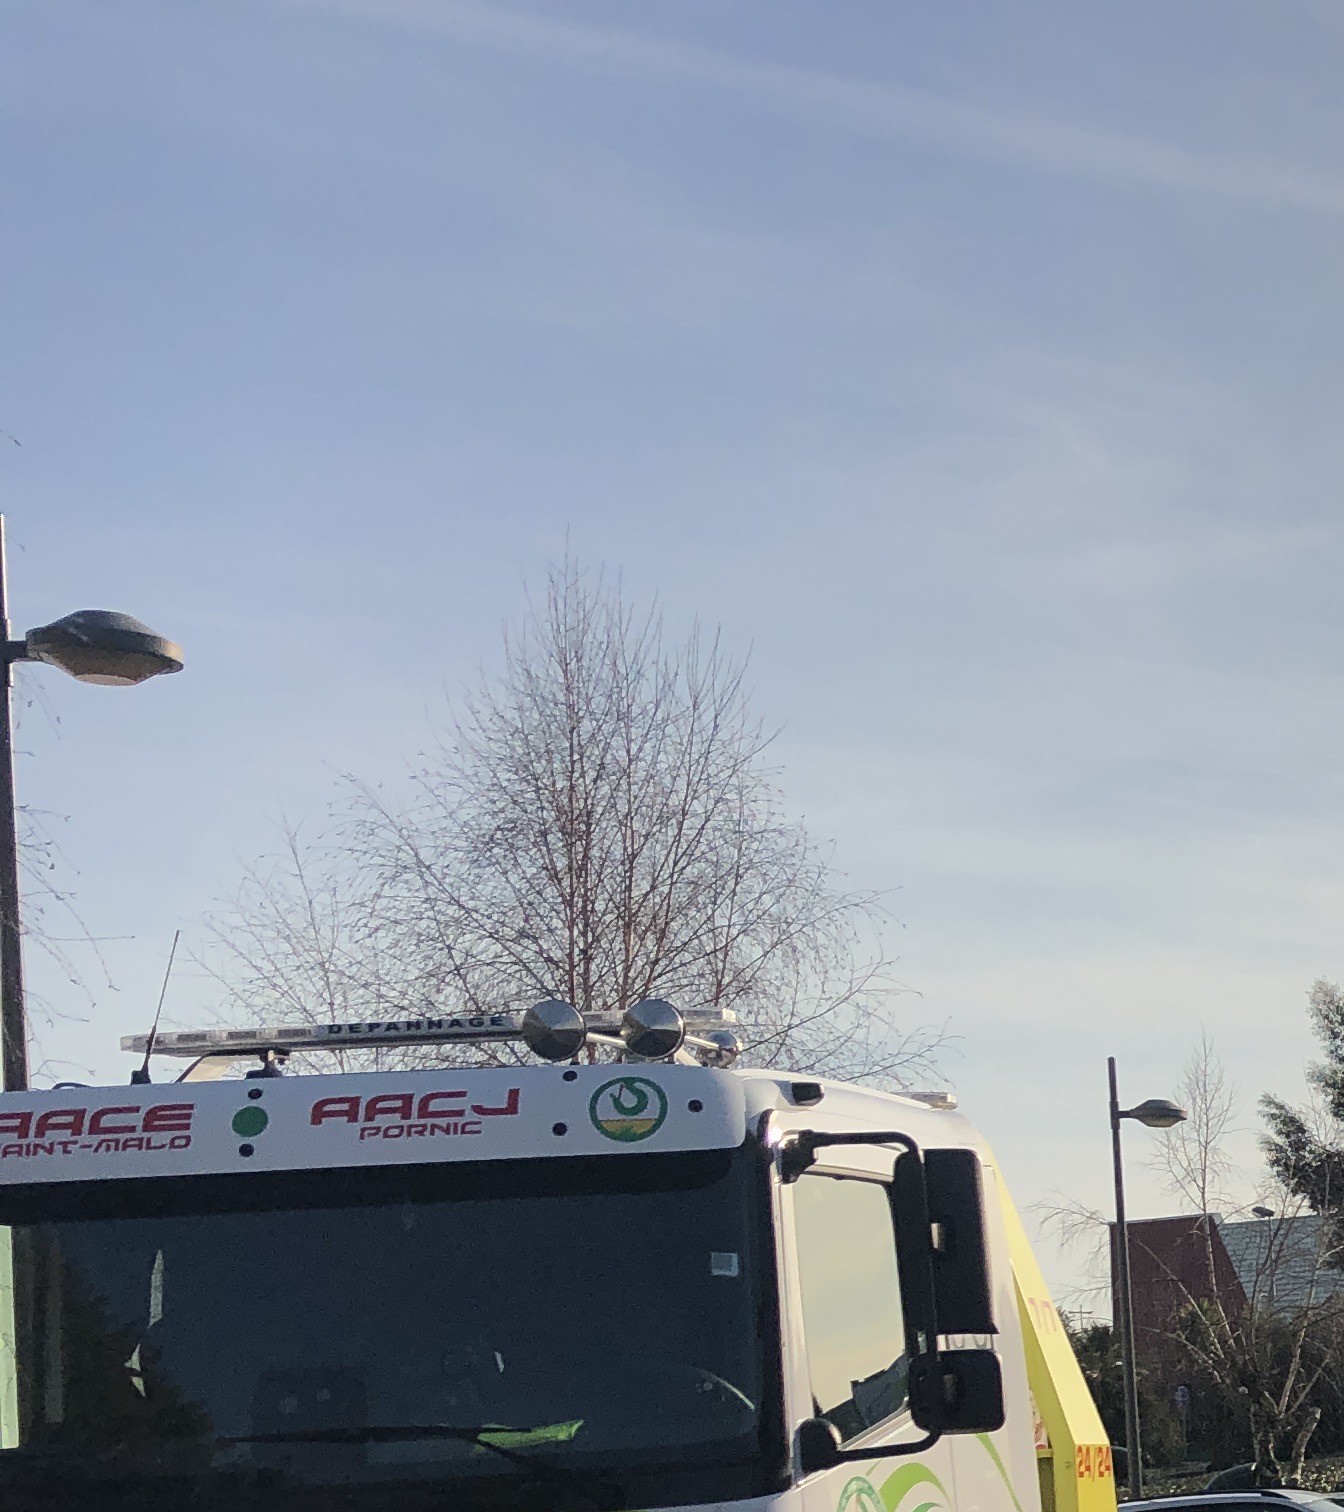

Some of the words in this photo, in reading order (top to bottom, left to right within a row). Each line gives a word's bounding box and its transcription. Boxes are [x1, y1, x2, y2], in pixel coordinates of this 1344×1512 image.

[327, 1017, 504, 1035] DEPANNAGE
[310, 1088, 520, 1125] AACJ
[359, 1121, 482, 1140] PORNIC
[0, 1134, 192, 1158] AINT-MALO
[1076, 1445, 1111, 1482] 24/24
